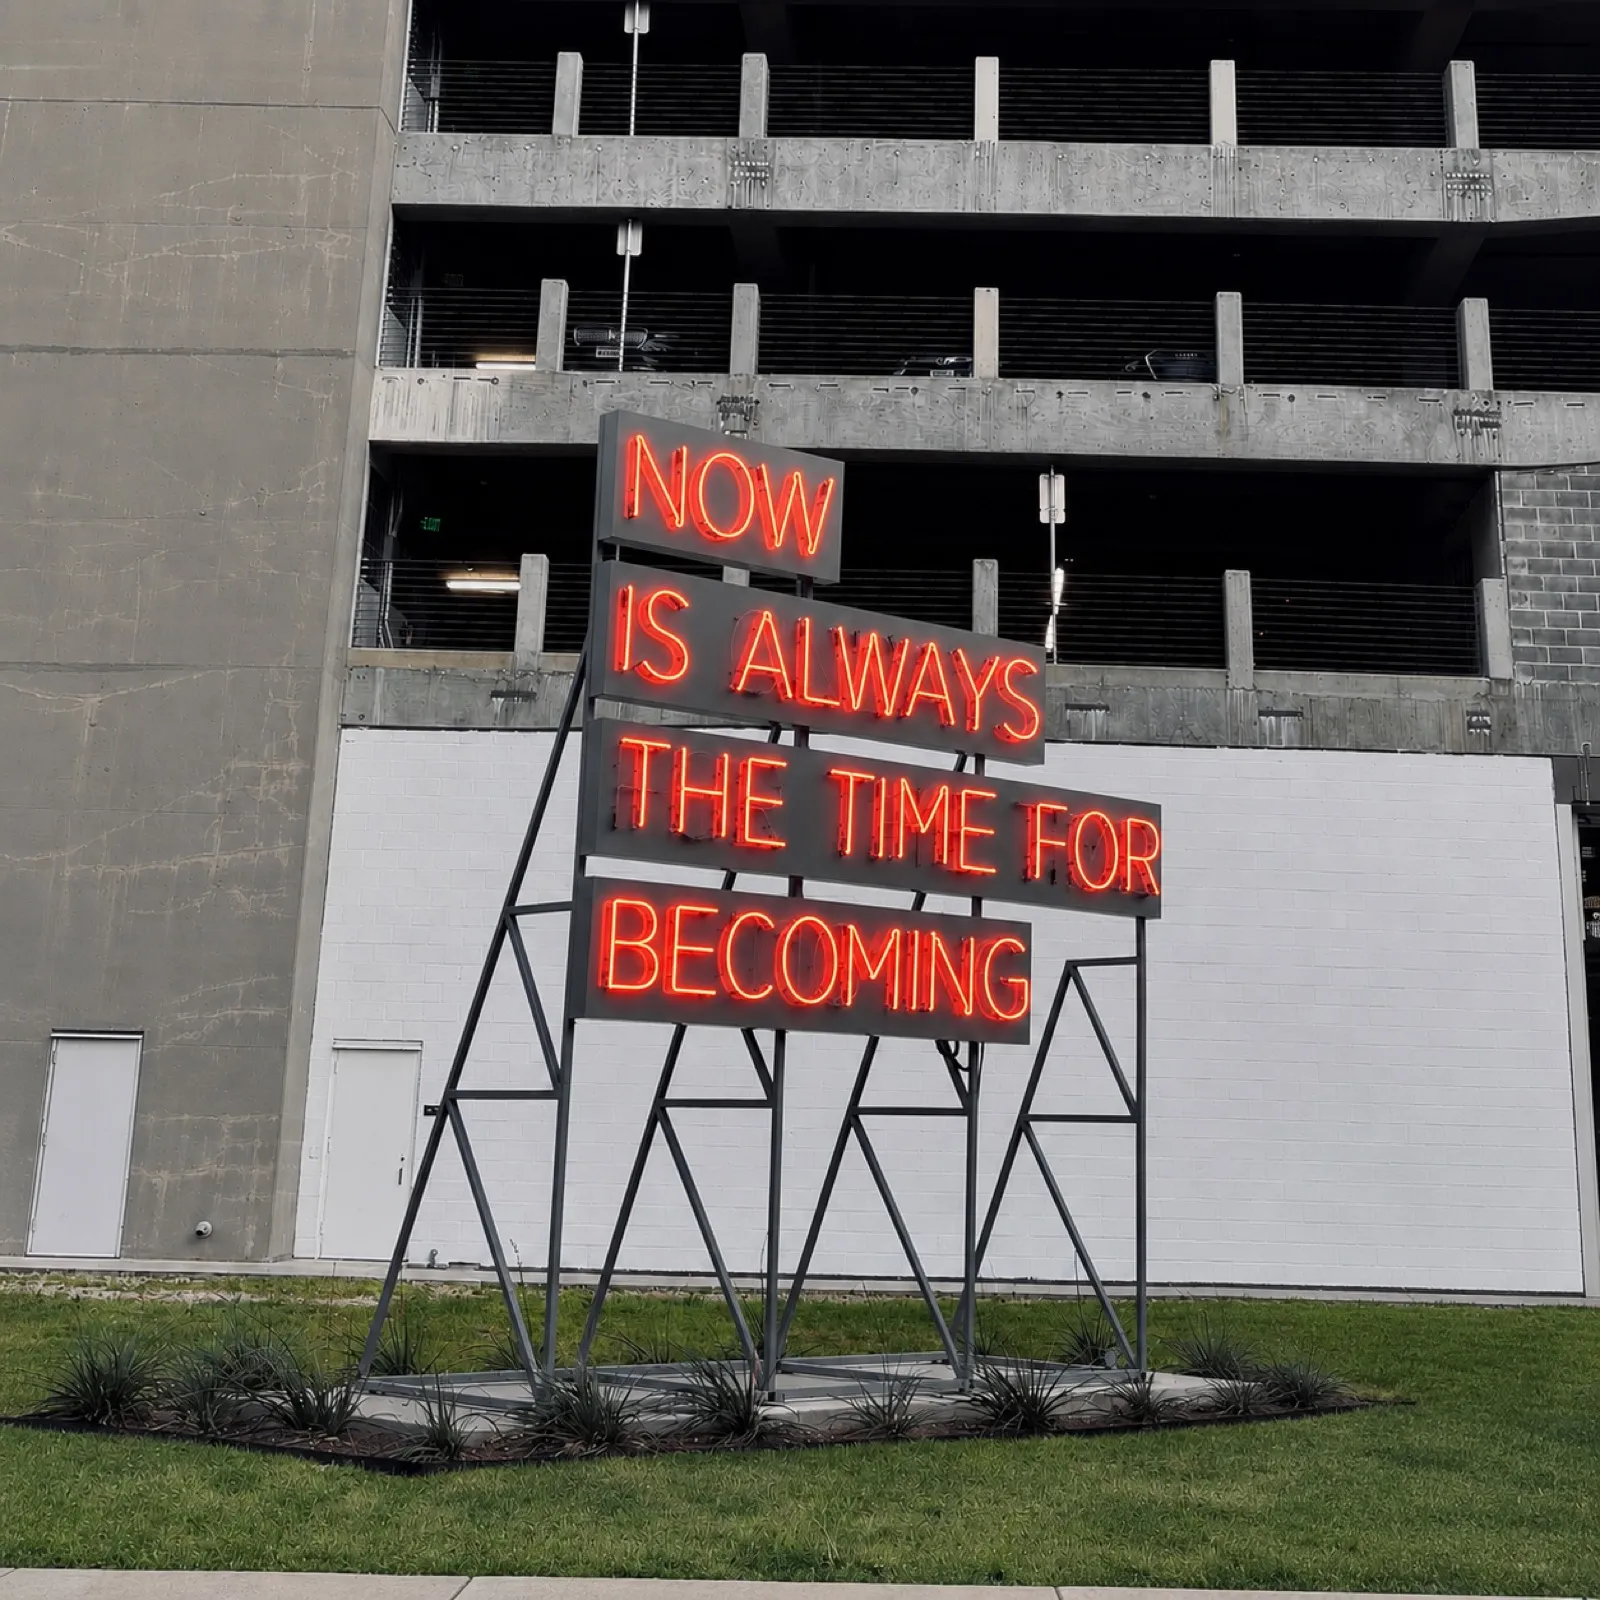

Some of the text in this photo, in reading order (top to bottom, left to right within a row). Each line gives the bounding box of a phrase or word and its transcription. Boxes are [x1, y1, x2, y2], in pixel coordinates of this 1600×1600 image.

[623, 434, 834, 558] NOW
[614, 584, 1041, 743] IS ALWAYS
[618, 736, 1161, 897] THE TIME FOR
[599, 897, 1030, 1022] BECOMING
